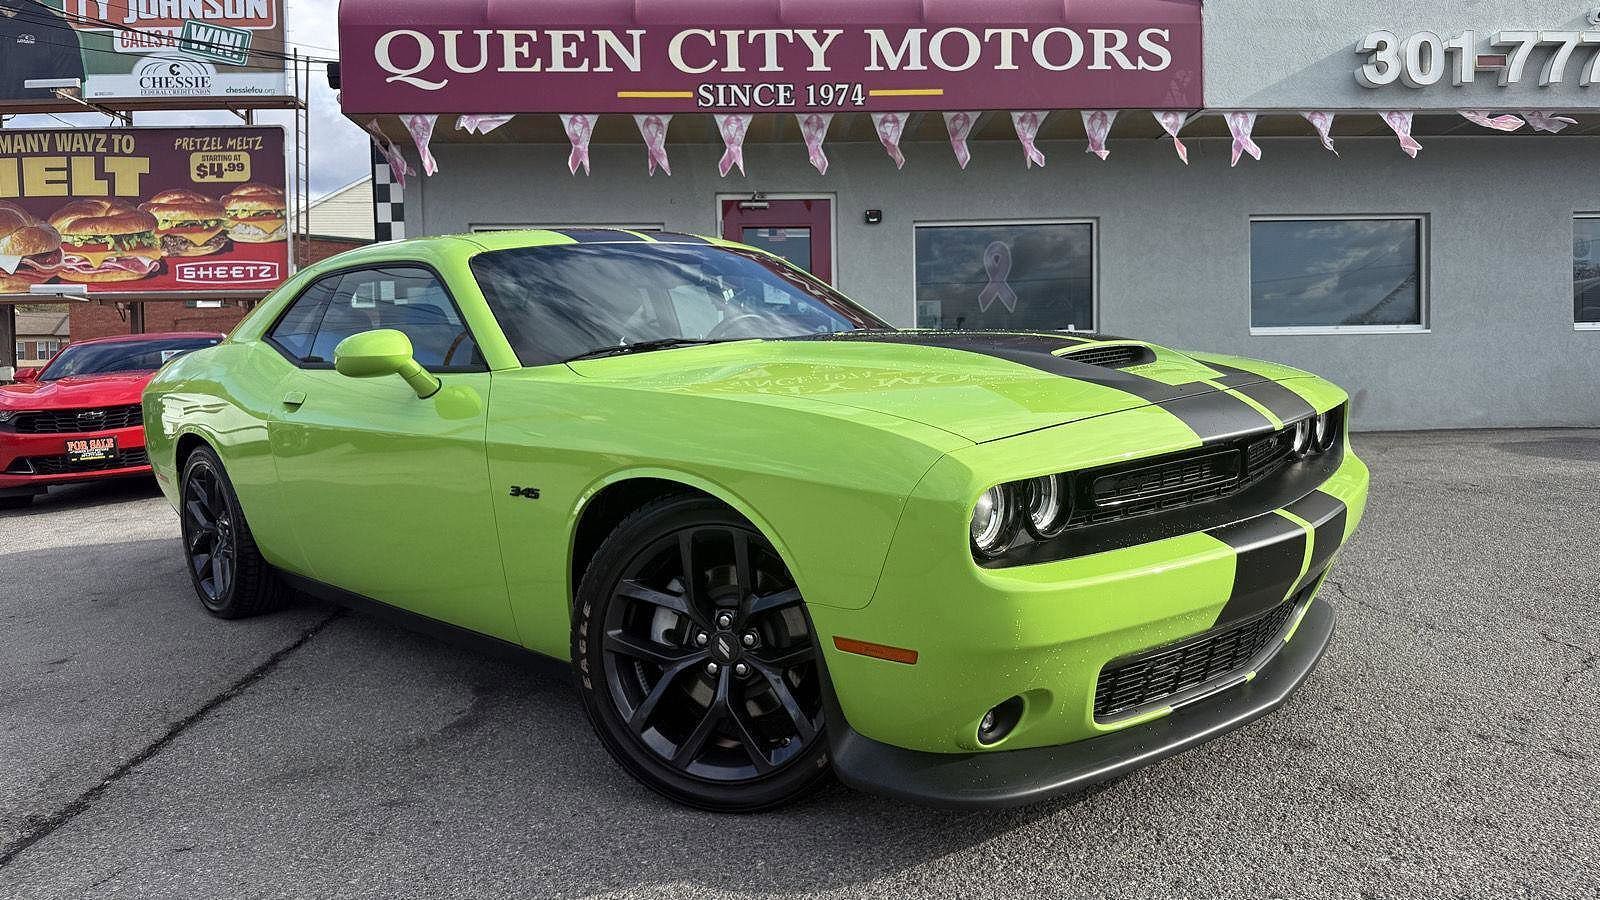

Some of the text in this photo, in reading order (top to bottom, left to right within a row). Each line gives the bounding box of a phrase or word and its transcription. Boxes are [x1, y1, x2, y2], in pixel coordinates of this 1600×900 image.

[120, 30, 176, 48] CALLS A
[374, 27, 1172, 90] QUEEN CITY MOTORS
[139, 76, 212, 89] CHESSIE
[697, 82, 866, 108] SINCE 1974
[55, 132, 107, 153] WAYZ
[111, 133, 135, 154] TO
[174, 135, 264, 151] PRETZEL MELTZ
[201, 154, 233, 162] STARTING
[196, 162, 246, 179] $4.99
[183, 264, 272, 280] SHEETZ
[66, 440, 88, 452] FOR
[89, 438, 114, 450] SALE
[509, 485, 541, 499] 345
